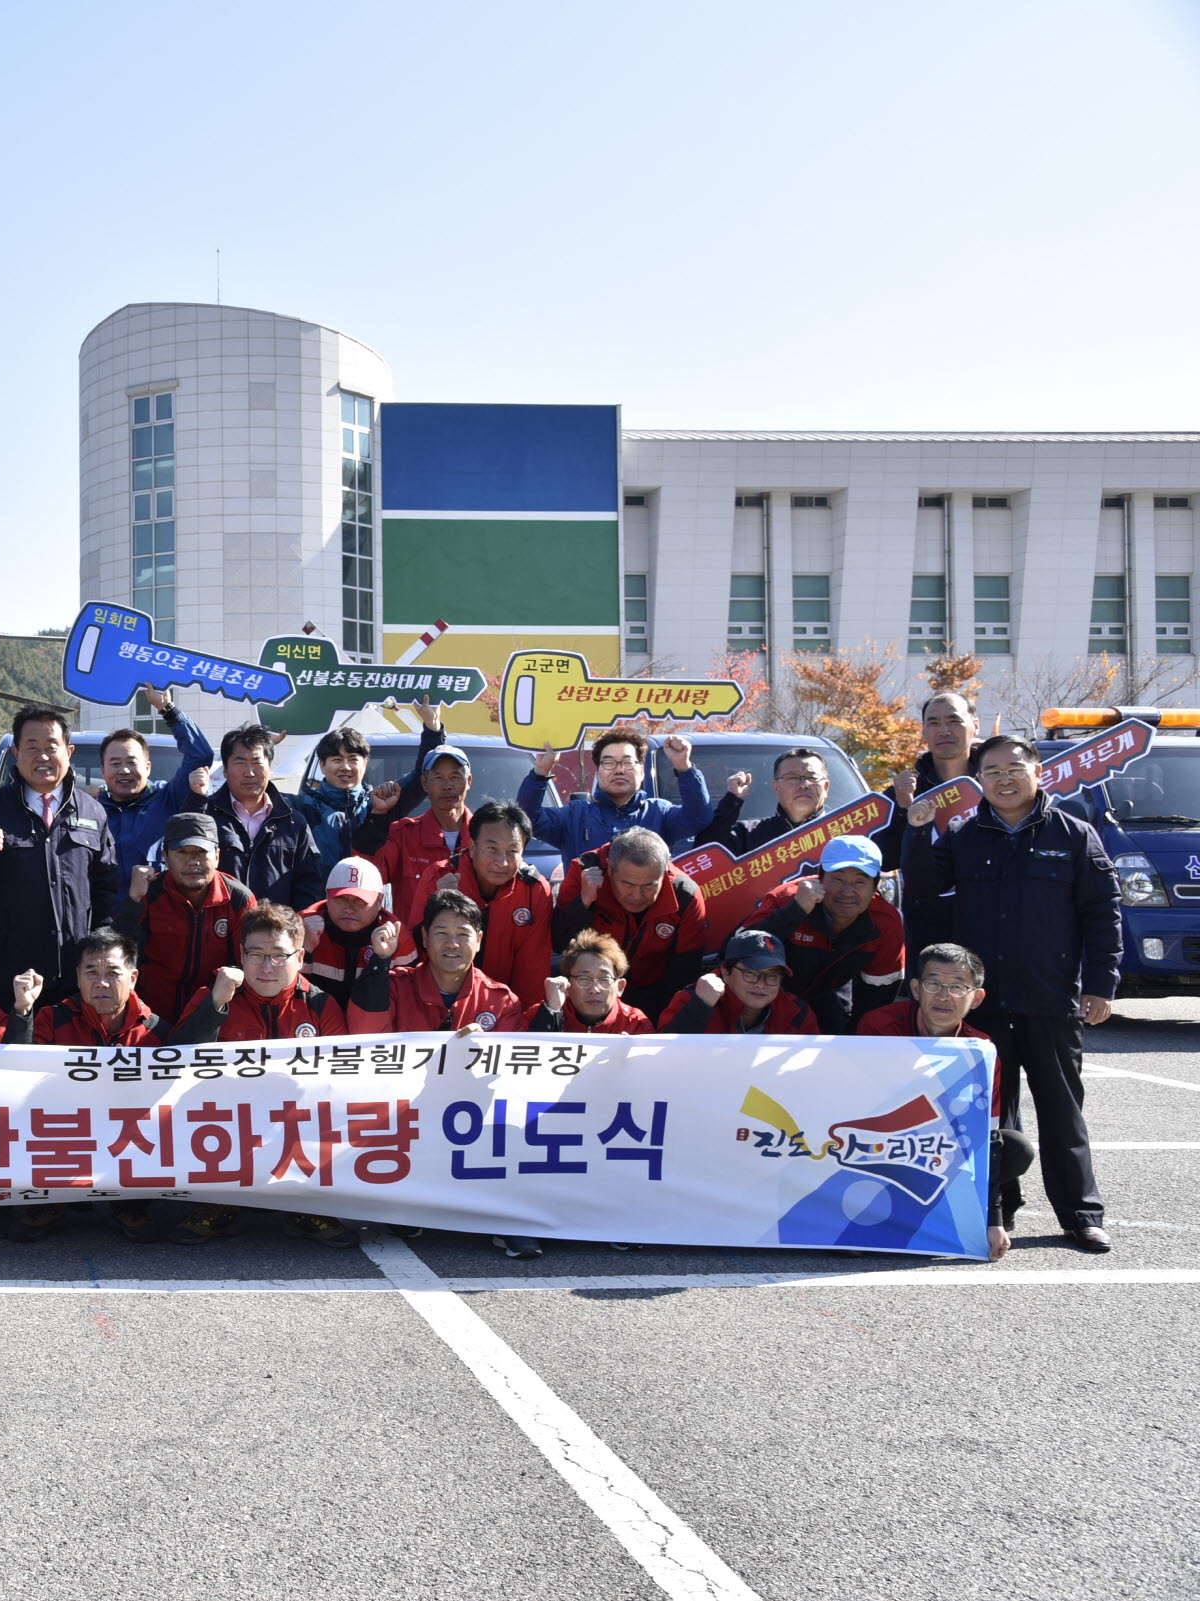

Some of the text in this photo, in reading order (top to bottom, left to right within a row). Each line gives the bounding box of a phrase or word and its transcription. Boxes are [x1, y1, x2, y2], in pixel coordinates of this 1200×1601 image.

[94, 608, 138, 631] 임회면
[276, 644, 321, 660] 의신면
[118, 641, 264, 690] 행동으로 산불조심
[522, 658, 570, 673] 고군면
[295, 669, 471, 692] 산불초동진화태세 확립
[557, 685, 710, 706] 산림보호 나라사랑
[1038, 759, 1074, 790] 르게
[1078, 730, 1135, 769] 푸르게
[934, 785, 962, 809] 내면
[748, 853, 774, 878] 강산
[775, 827, 826, 864] 후손에게
[826, 801, 879, 838] 물려주자
[347, 866, 359, 883] B
[681, 853, 713, 876] 도읍
[64, 1047, 271, 1082] 공설운동장
[285, 1043, 448, 1076] 산불헬기
[464, 1044, 588, 1077] 계류장
[441, 1098, 669, 1182] 인도식
